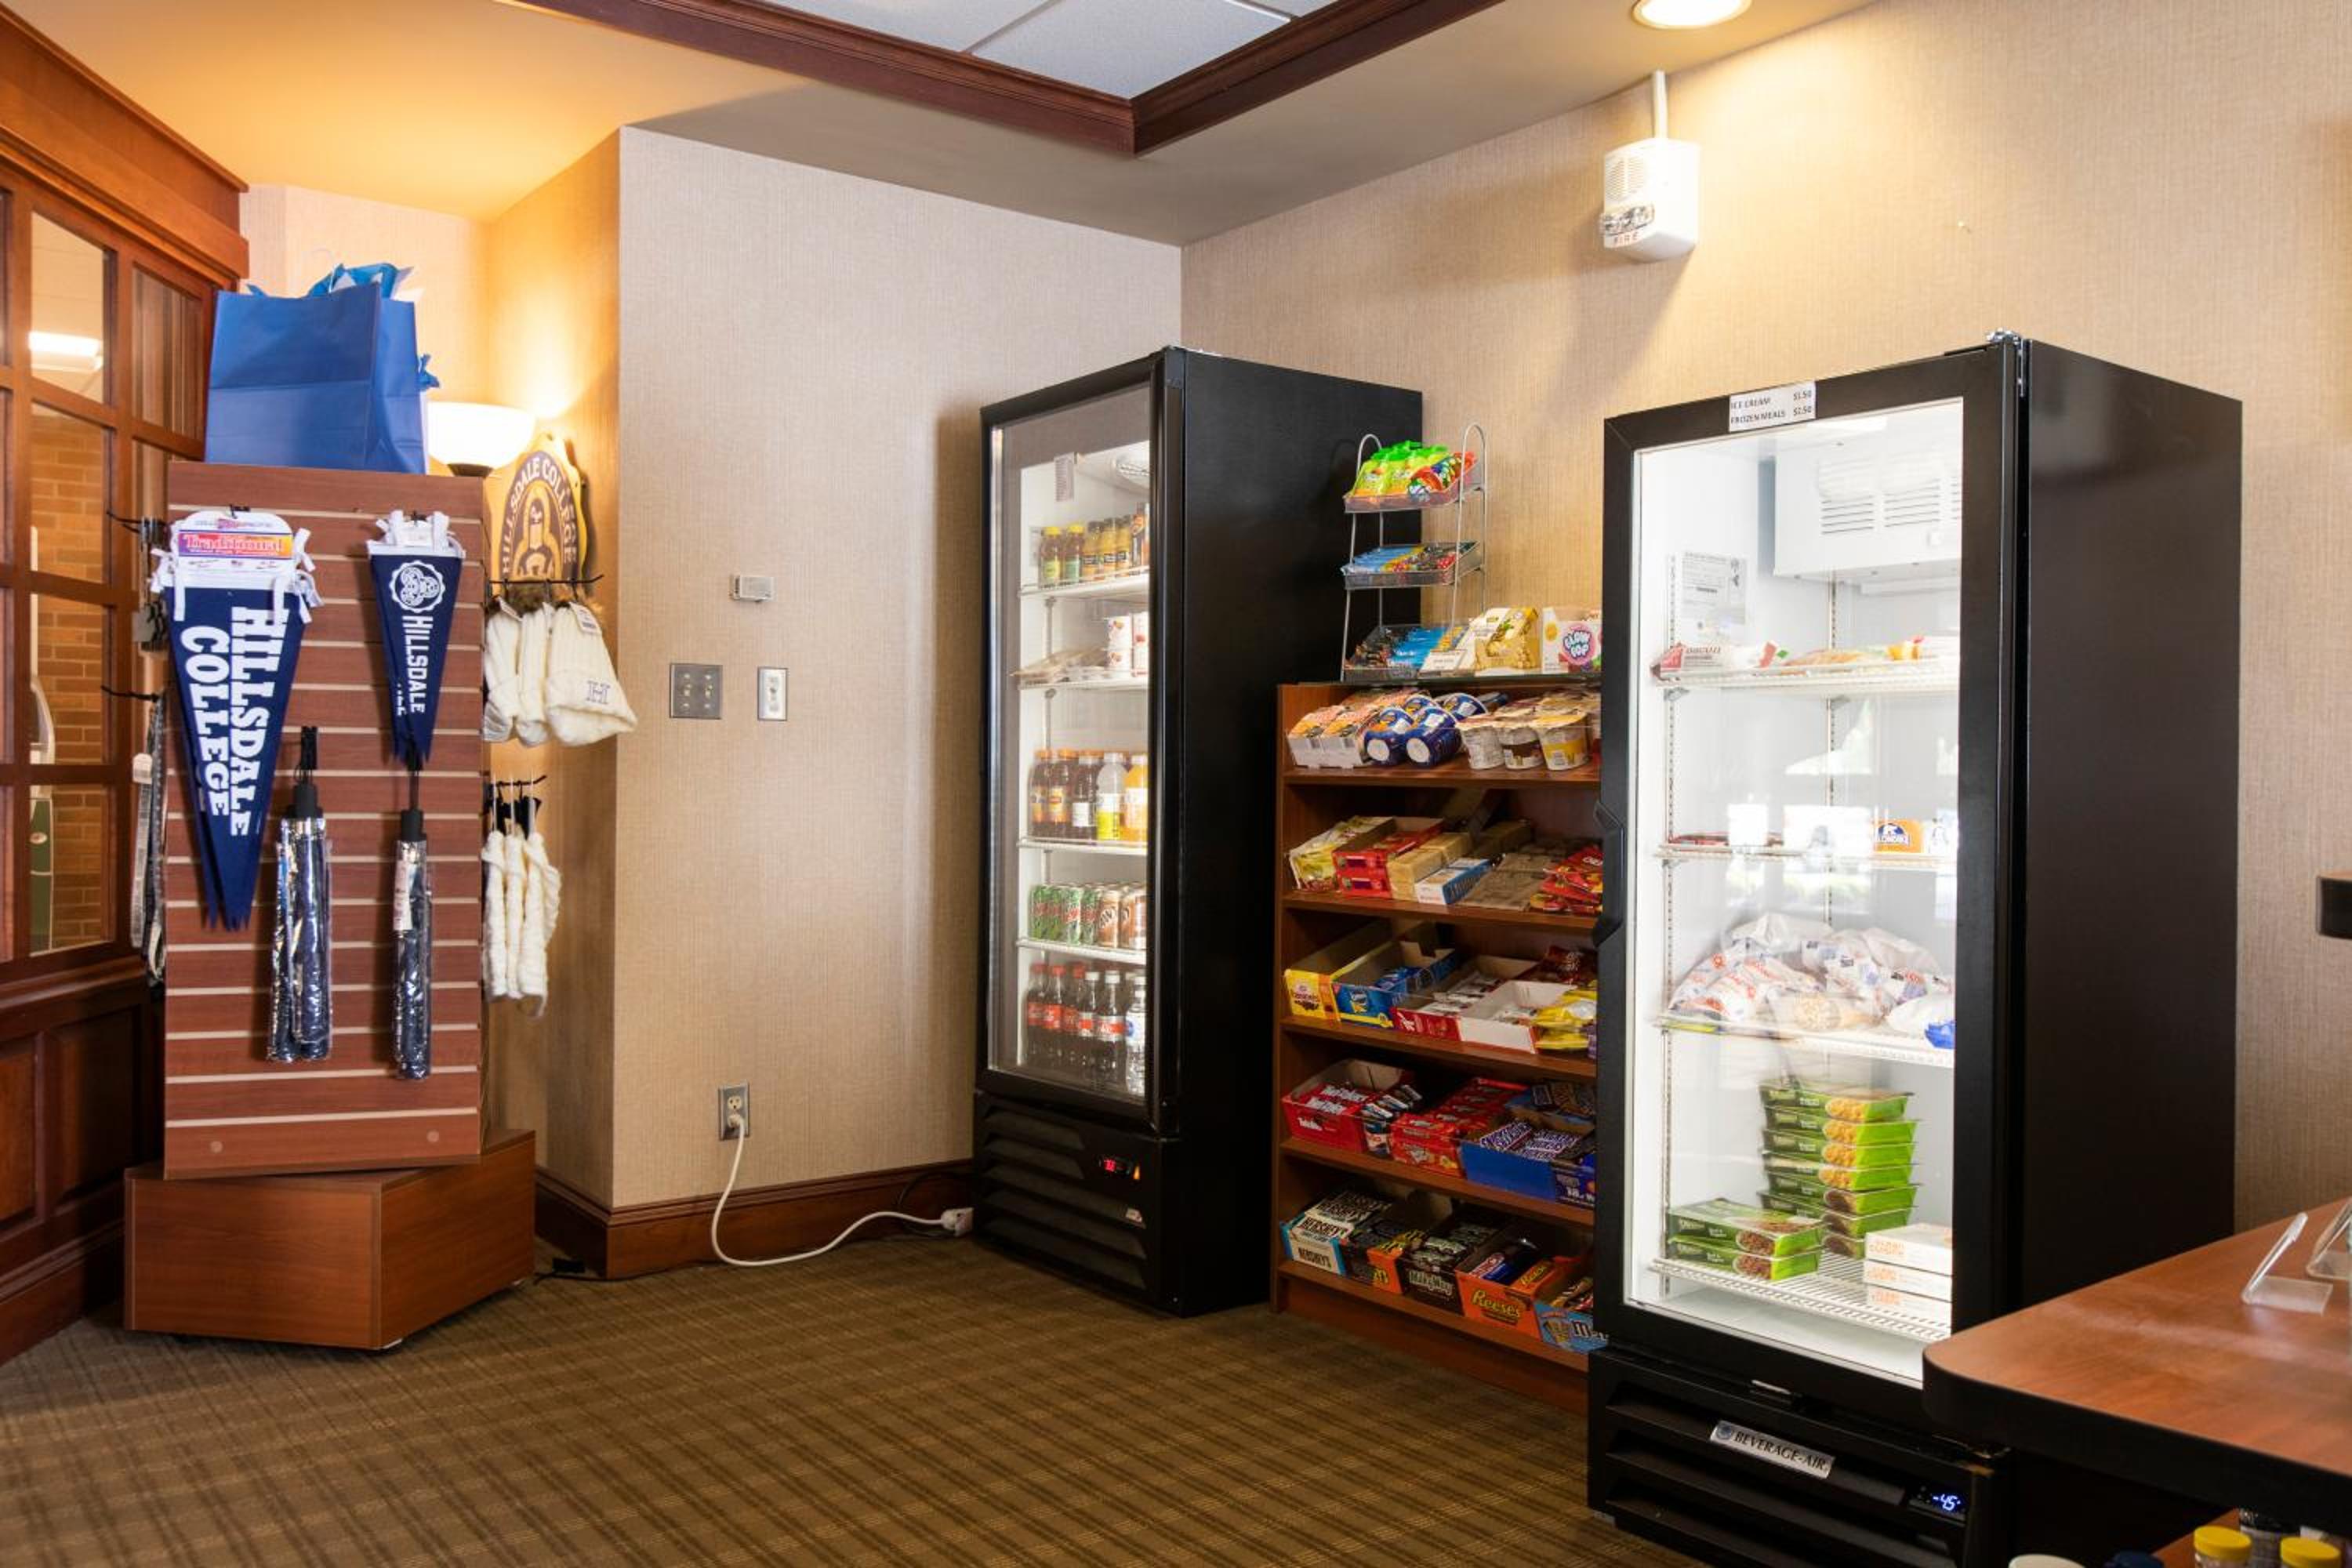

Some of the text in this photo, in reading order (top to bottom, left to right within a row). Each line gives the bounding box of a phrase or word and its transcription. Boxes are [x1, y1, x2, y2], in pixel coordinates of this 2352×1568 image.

[1730, 390, 1812, 410] ICE CREAM $1.50
[1730, 412, 1760, 424] FROZEN
[1760, 410, 1786, 420] MEALS
[503, 457, 577, 574] HILLSDALE COLLEGE
[402, 615, 434, 714] HILLSDALE
[586, 680, 611, 705] H
[180, 626, 230, 816] COLLEGE
[230, 607, 290, 836] HILLSDALE
[1733, 1430, 1827, 1471] BEVERAGE-AIR
